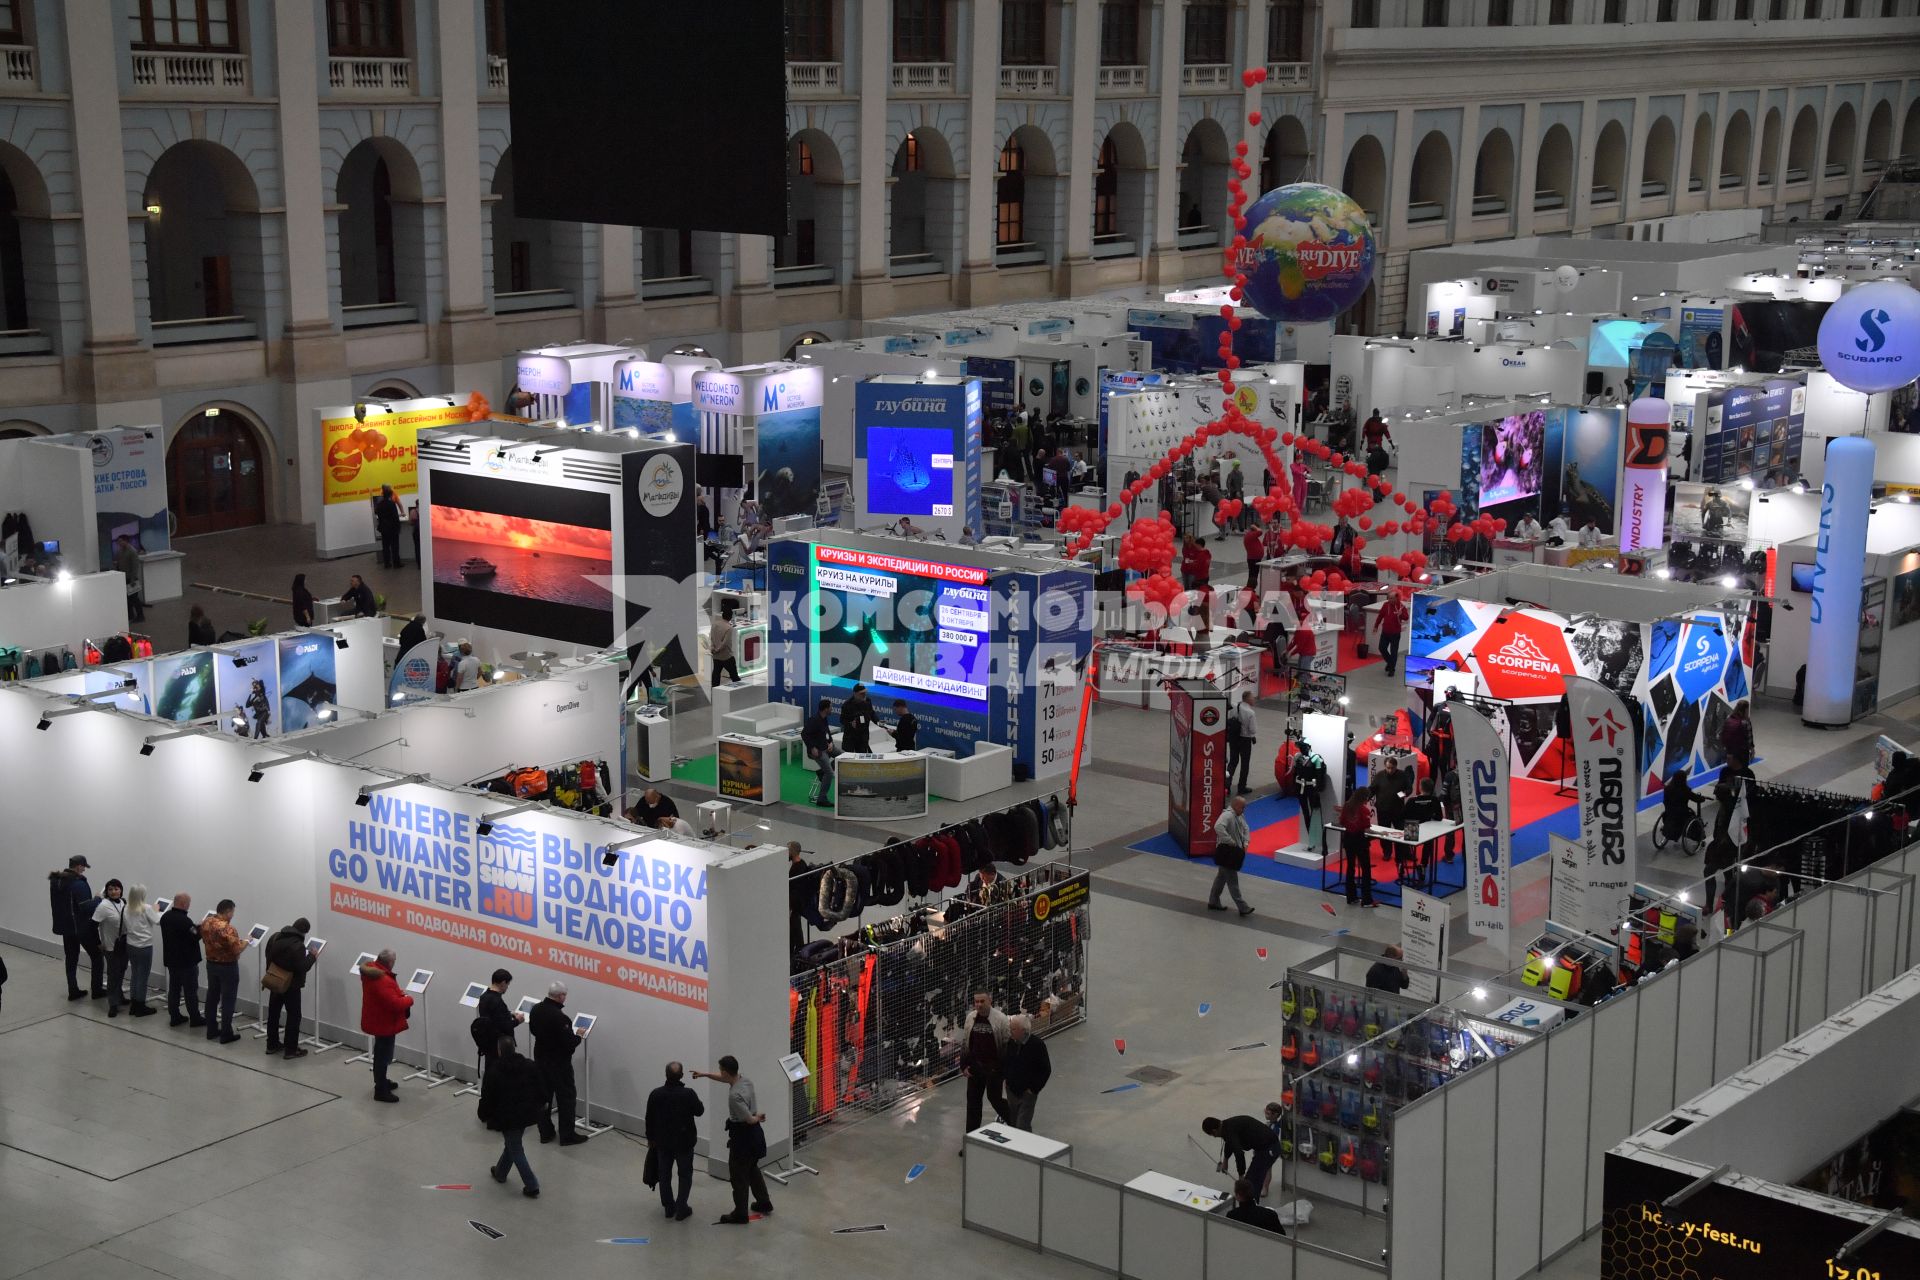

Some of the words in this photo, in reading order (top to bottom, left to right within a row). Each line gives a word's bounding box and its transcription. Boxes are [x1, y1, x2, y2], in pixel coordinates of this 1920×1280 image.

[1837, 351, 1903, 363] SCUBAPRO
[695, 380, 729, 393] WELCOME
[731, 384, 740, 395] TO
[874, 397, 947, 415] глубина
[111, 469, 146, 481] ОСТРОВА
[1631, 483, 1644, 550] INDUSTRY
[820, 548, 857, 562] КРУИЗЫ
[858, 555, 865, 564] И
[866, 556, 929, 574] ЭКСПЕДИЦИИ
[929, 564, 944, 575] ПО
[945, 566, 984, 582] РОССИИ
[817, 568, 844, 582] КРУИЗ
[846, 574, 857, 583] НА
[859, 575, 895, 589] КУРИЛЫ
[943, 587, 988, 602] глубина
[950, 608, 982, 619] СЕНТЯБРЯ
[955, 633, 968, 642] 000
[303, 644, 318, 653] PADI
[181, 666, 196, 675] PADI
[1487, 653, 1561, 675] SCORPENA
[1684, 652, 1719, 673] SCORPENA
[874, 668, 916, 687] ДАЙВИНГ
[925, 679, 985, 698] ФРИДАЙВИНГ
[1501, 668, 1547, 681] scorpena.ru
[1043, 682, 1055, 699] 71
[556, 700, 580, 713] OpenDive
[1042, 704, 1055, 721] 13
[915, 714, 939, 724] АНТАРЫ
[952, 721, 981, 732] КУРИЛЫ
[934, 728, 971, 740] ПРИМОРЬЕ
[1042, 727, 1055, 744] 14
[1041, 747, 1055, 765] 50
[1202, 758, 1213, 833] SCORPENA
[369, 793, 471, 845] WHERE
[349, 820, 471, 876] HUMANS
[479, 843, 535, 875] DIVE
[543, 834, 708, 901] ВЫСТАВКА
[329, 848, 368, 884] GO
[376, 860, 472, 911] WATER
[479, 868, 535, 894] SHOW
[484, 888, 533, 922] .RU
[543, 869, 693, 932] ВОДНОГО
[333, 890, 392, 918] ДАЙВИНГ
[406, 910, 487, 945] ПОДВОДНАЯ
[490, 933, 533, 957] ОХОТА
[548, 946, 601, 973] ЯХТИНГ
[543, 902, 708, 973] ЧЕЛОВЕКА
[1642, 1204, 1761, 1254] hoy-fest.ru
